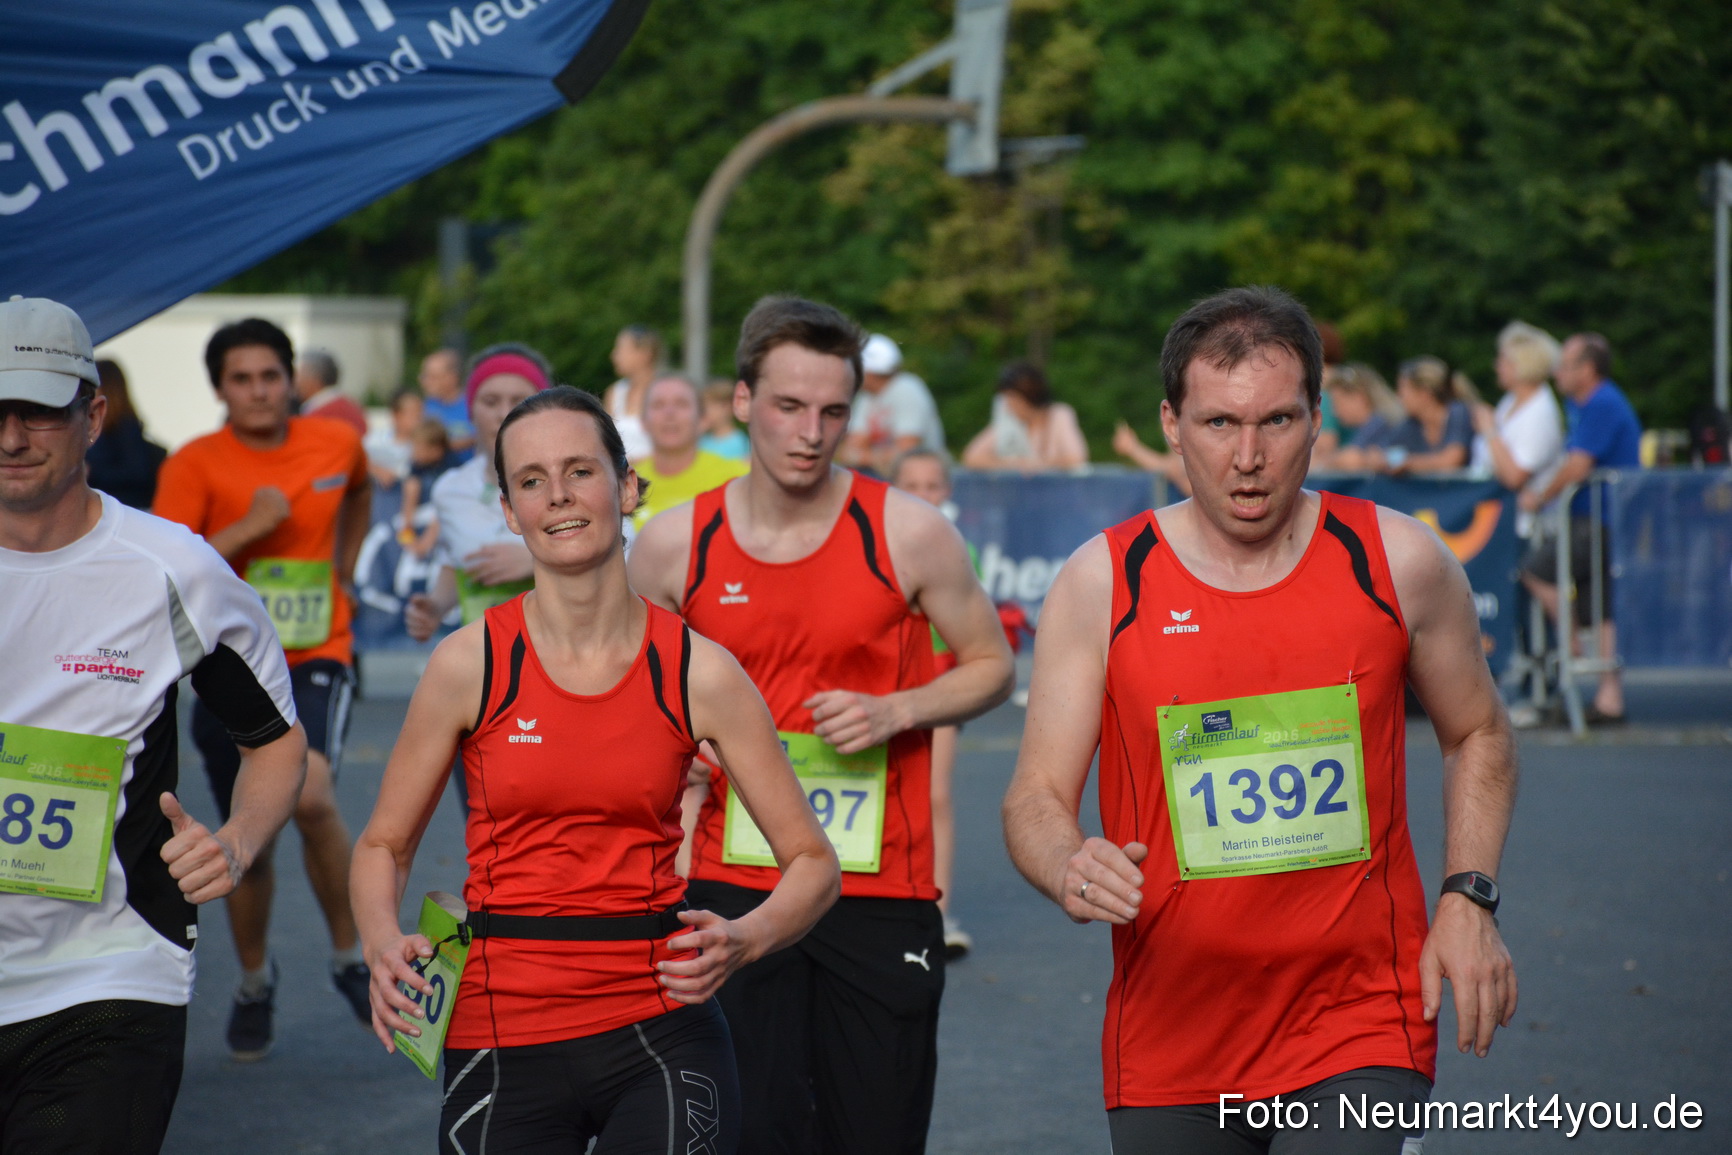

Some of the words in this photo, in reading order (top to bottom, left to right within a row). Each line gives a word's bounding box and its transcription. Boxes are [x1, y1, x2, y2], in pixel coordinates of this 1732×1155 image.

[176, 81, 328, 181] Druck
[330, 34, 428, 100] und
[719, 594, 749, 604] erima
[1163, 624, 1200, 635] erima
[54, 654, 118, 665] guttenberger
[97, 648, 129, 659] TEAM
[74, 663, 145, 678] partner
[508, 734, 543, 744] erima
[1191, 724, 1260, 745] firmenlauf
[1263, 729, 1299, 744] 2016
[27, 762, 64, 777] 2016
[1189, 758, 1349, 828] 1392
[0, 793, 76, 850] 85
[1222, 838, 1259, 851] Martin
[1261, 832, 1325, 847] Bleisteiner
[1221, 854, 1252, 862] Sparkasse
[1252, 847, 1311, 860] Neumarkt-Parsberg
[11, 858, 46, 871] Muehl
